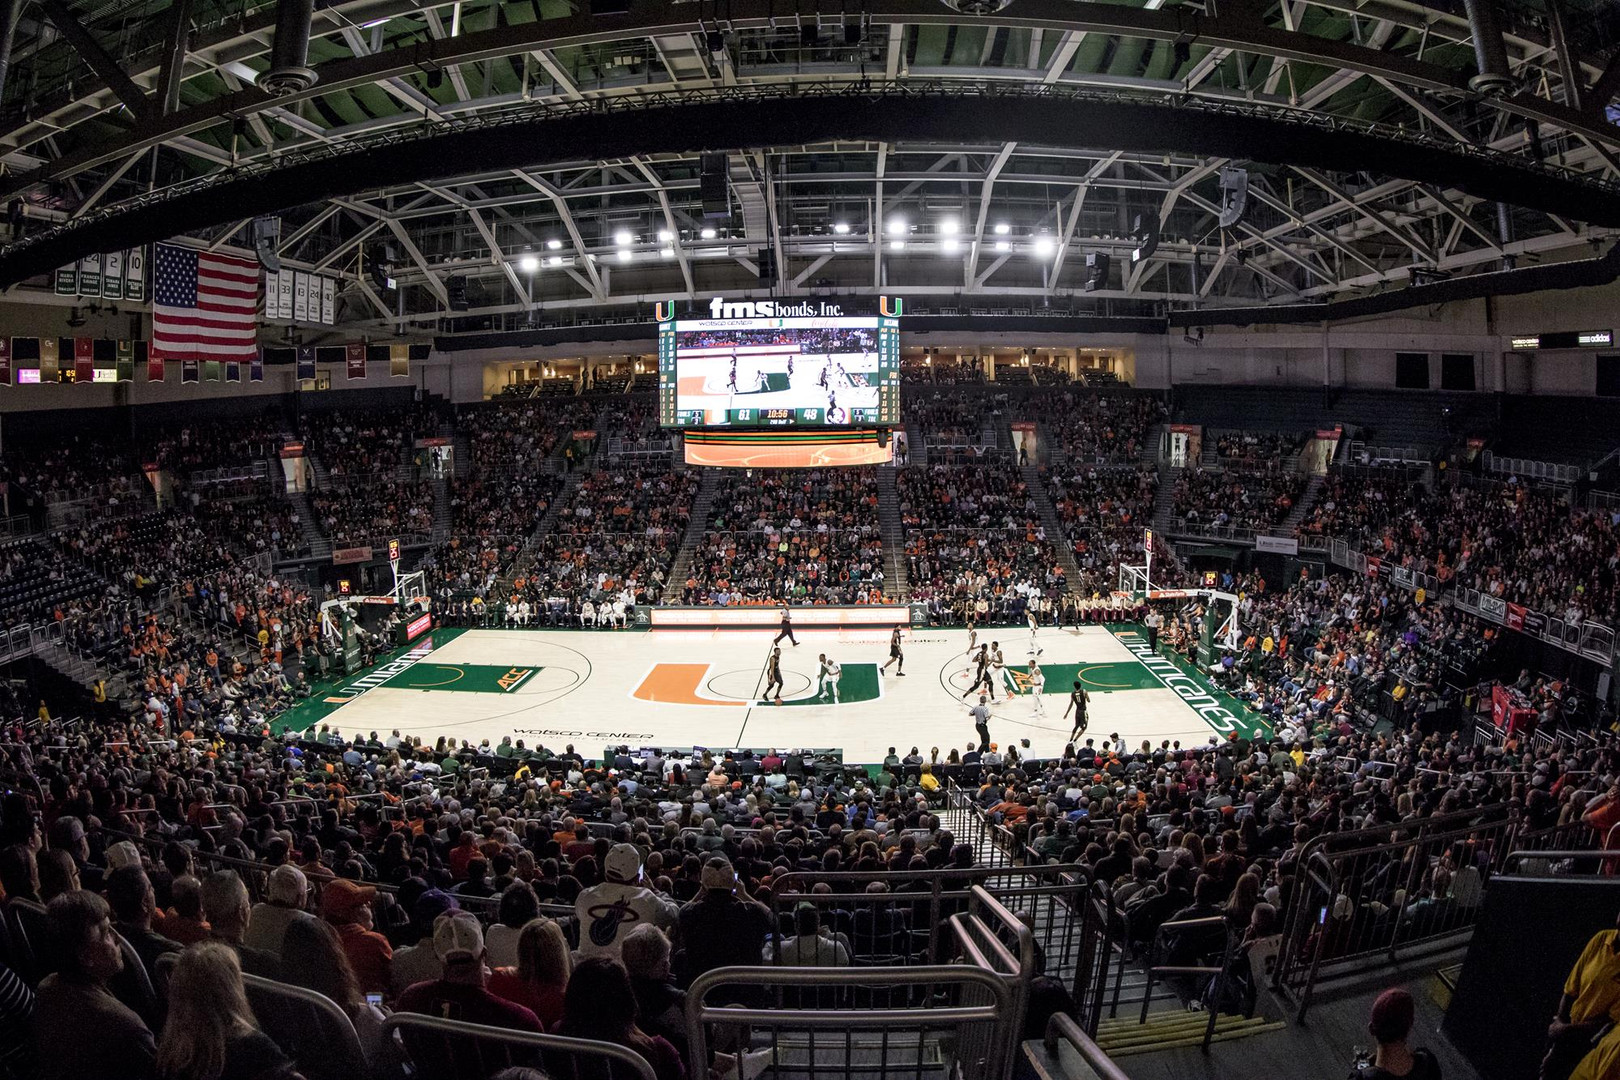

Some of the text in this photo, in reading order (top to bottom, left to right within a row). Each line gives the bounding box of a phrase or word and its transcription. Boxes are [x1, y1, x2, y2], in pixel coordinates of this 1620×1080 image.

[110, 256, 118, 268] 2
[131, 256, 141, 269] 10
[269, 285, 275, 294] 11
[281, 285, 291, 294] 33
[298, 288, 305, 297] 13
[310, 290, 319, 299] 24
[820, 302, 844, 316] Inc.
[1590, 334, 1610, 343] adidas
[768, 410, 788, 418] 10:56
[803, 409, 817, 420] 48
[497, 668, 529, 690] ACC
